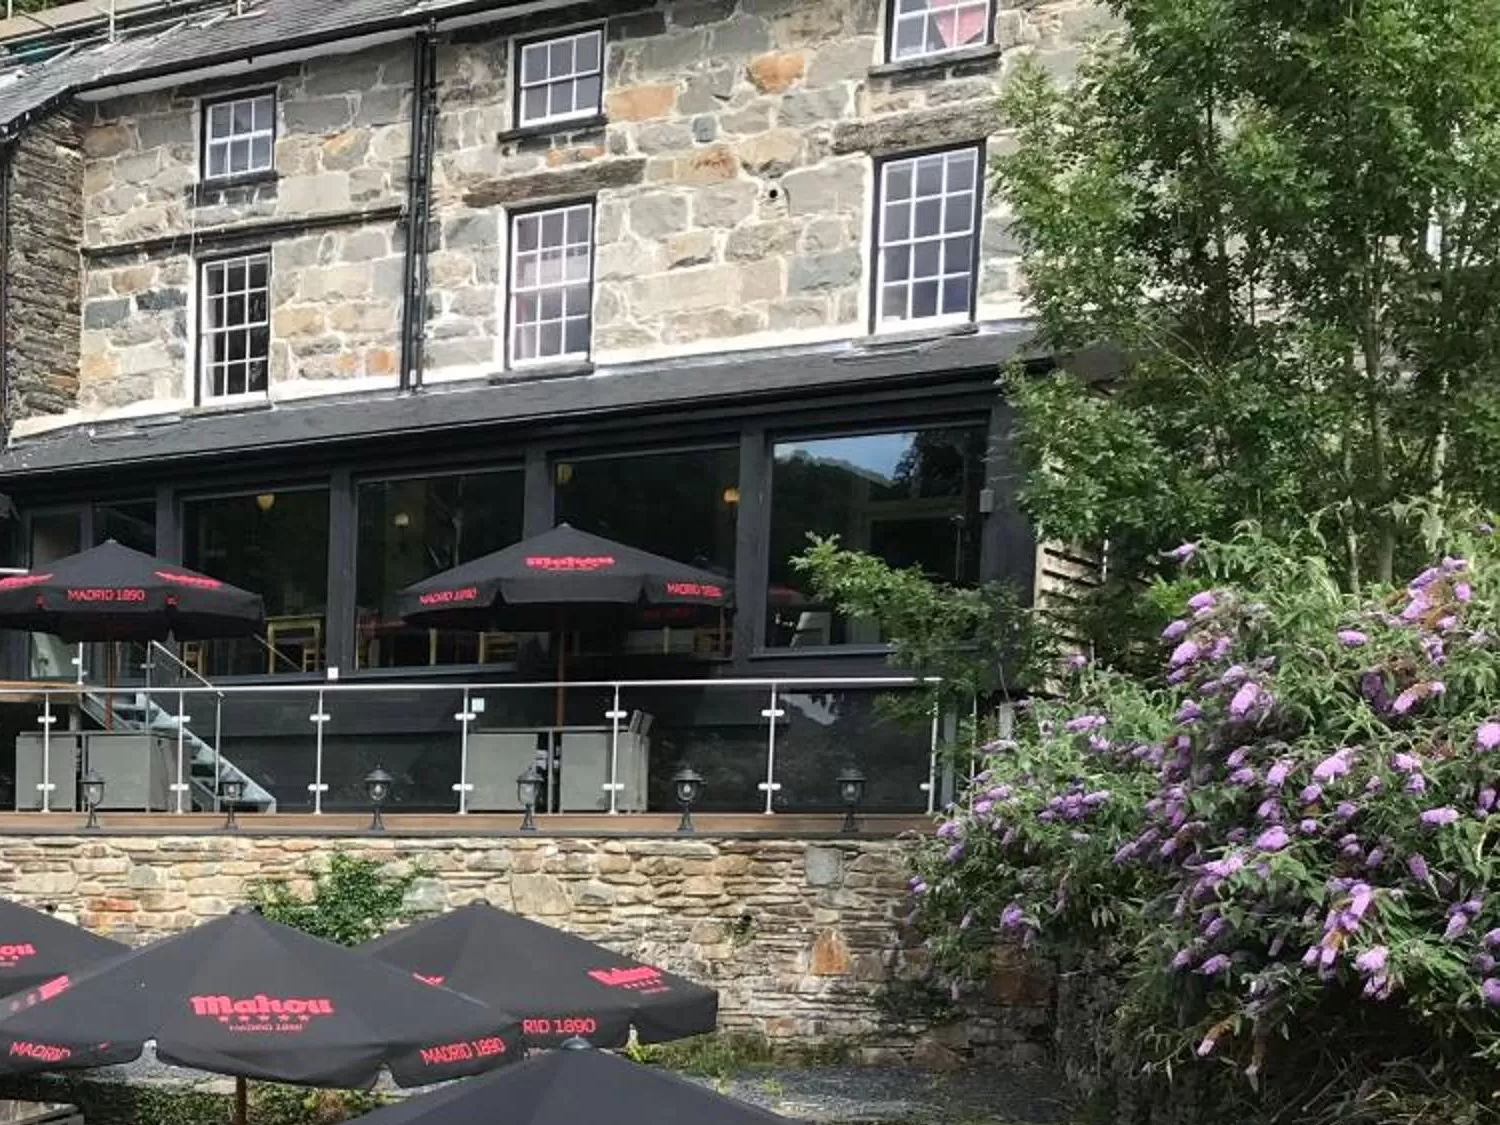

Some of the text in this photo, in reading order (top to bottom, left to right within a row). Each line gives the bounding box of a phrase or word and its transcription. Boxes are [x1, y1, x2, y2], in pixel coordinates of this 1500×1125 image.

[67, 589, 113, 601] MADRID
[190, 994, 334, 1014] Mahou
[522, 1018, 596, 1034] RID 1890
